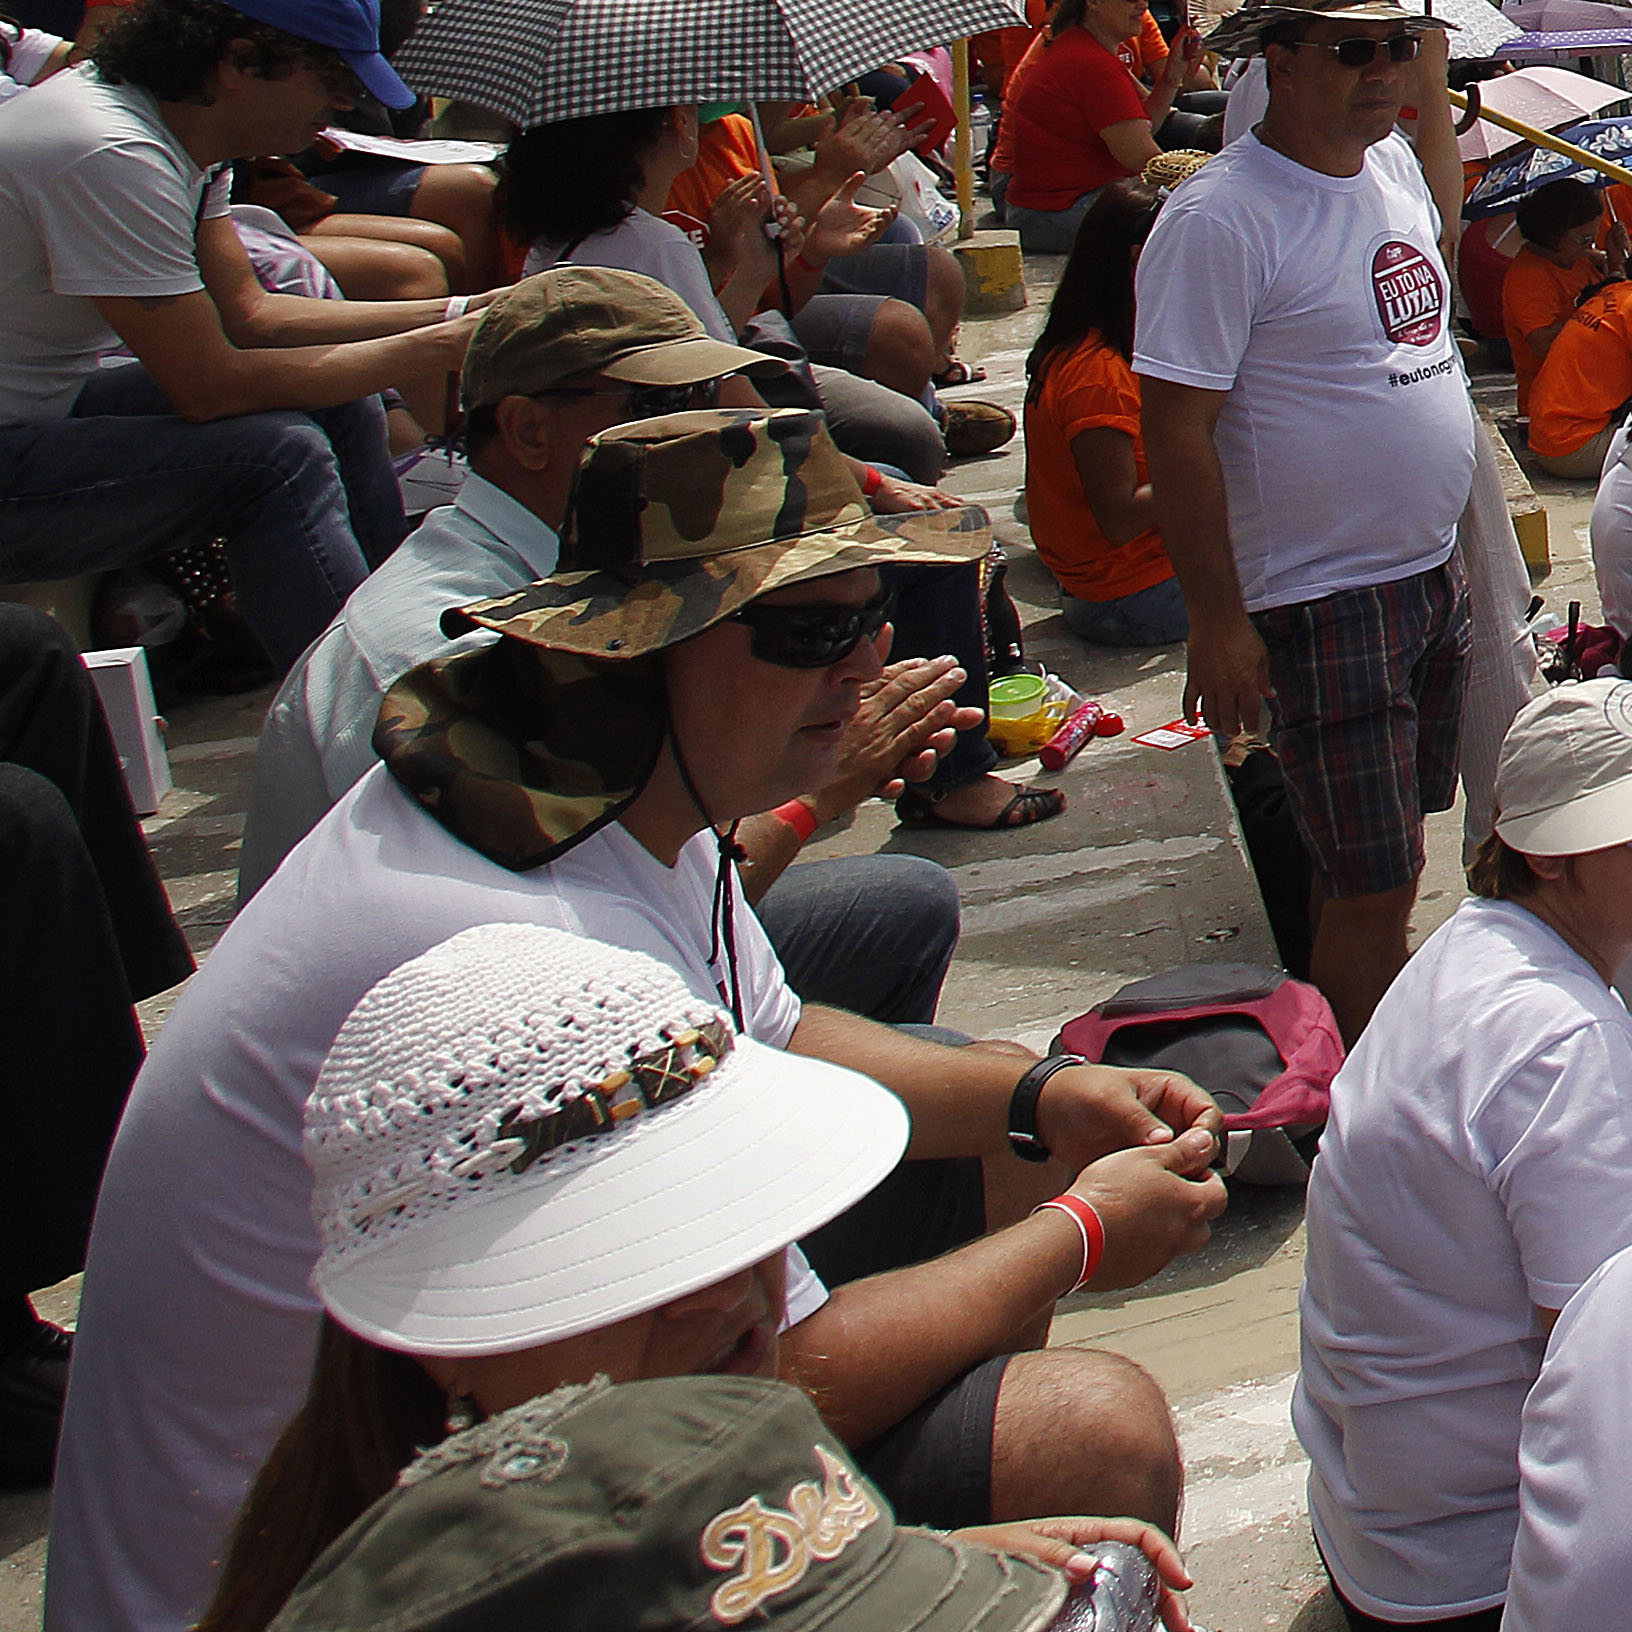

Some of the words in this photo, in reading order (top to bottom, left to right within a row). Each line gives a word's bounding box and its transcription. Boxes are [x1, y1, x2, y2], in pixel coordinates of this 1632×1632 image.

[1379, 278, 1399, 302] EU
[1399, 269, 1416, 296] TÔ
[1416, 264, 1436, 286] NA
[1386, 281, 1440, 328] LUTA!
